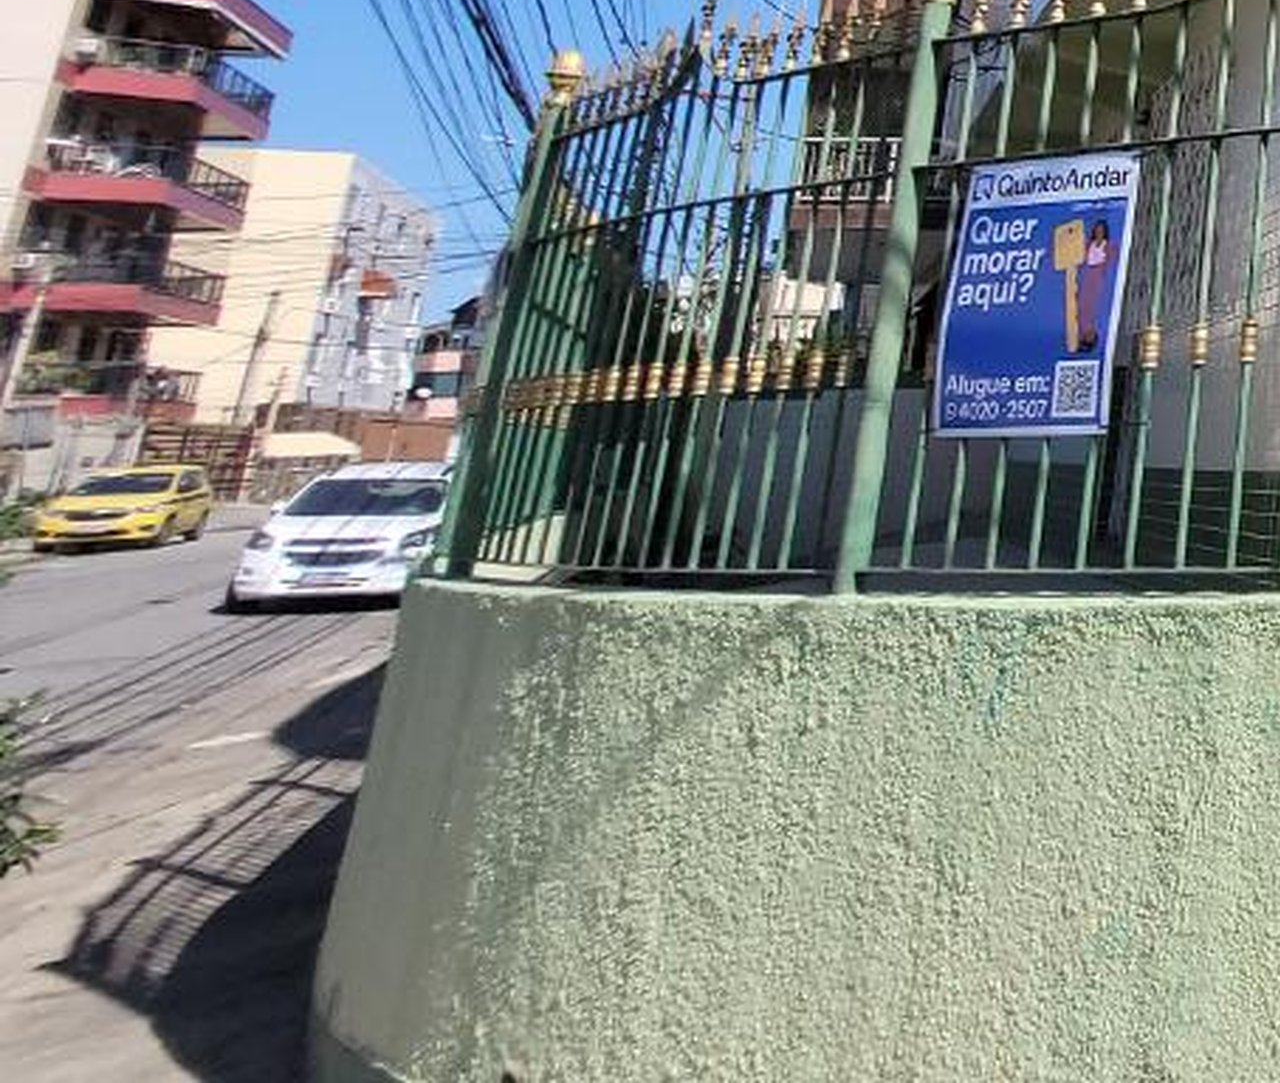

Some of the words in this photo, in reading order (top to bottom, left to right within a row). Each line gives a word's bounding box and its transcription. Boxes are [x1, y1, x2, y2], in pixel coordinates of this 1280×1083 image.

[998, 166, 1130, 198] QuintoAndar
[971, 217, 1038, 244] Quer
[963, 248, 1045, 274] morar
[958, 274, 1034, 311] aqui?
[945, 374, 1011, 399] Alugue
[1014, 375, 1051, 394] em:
